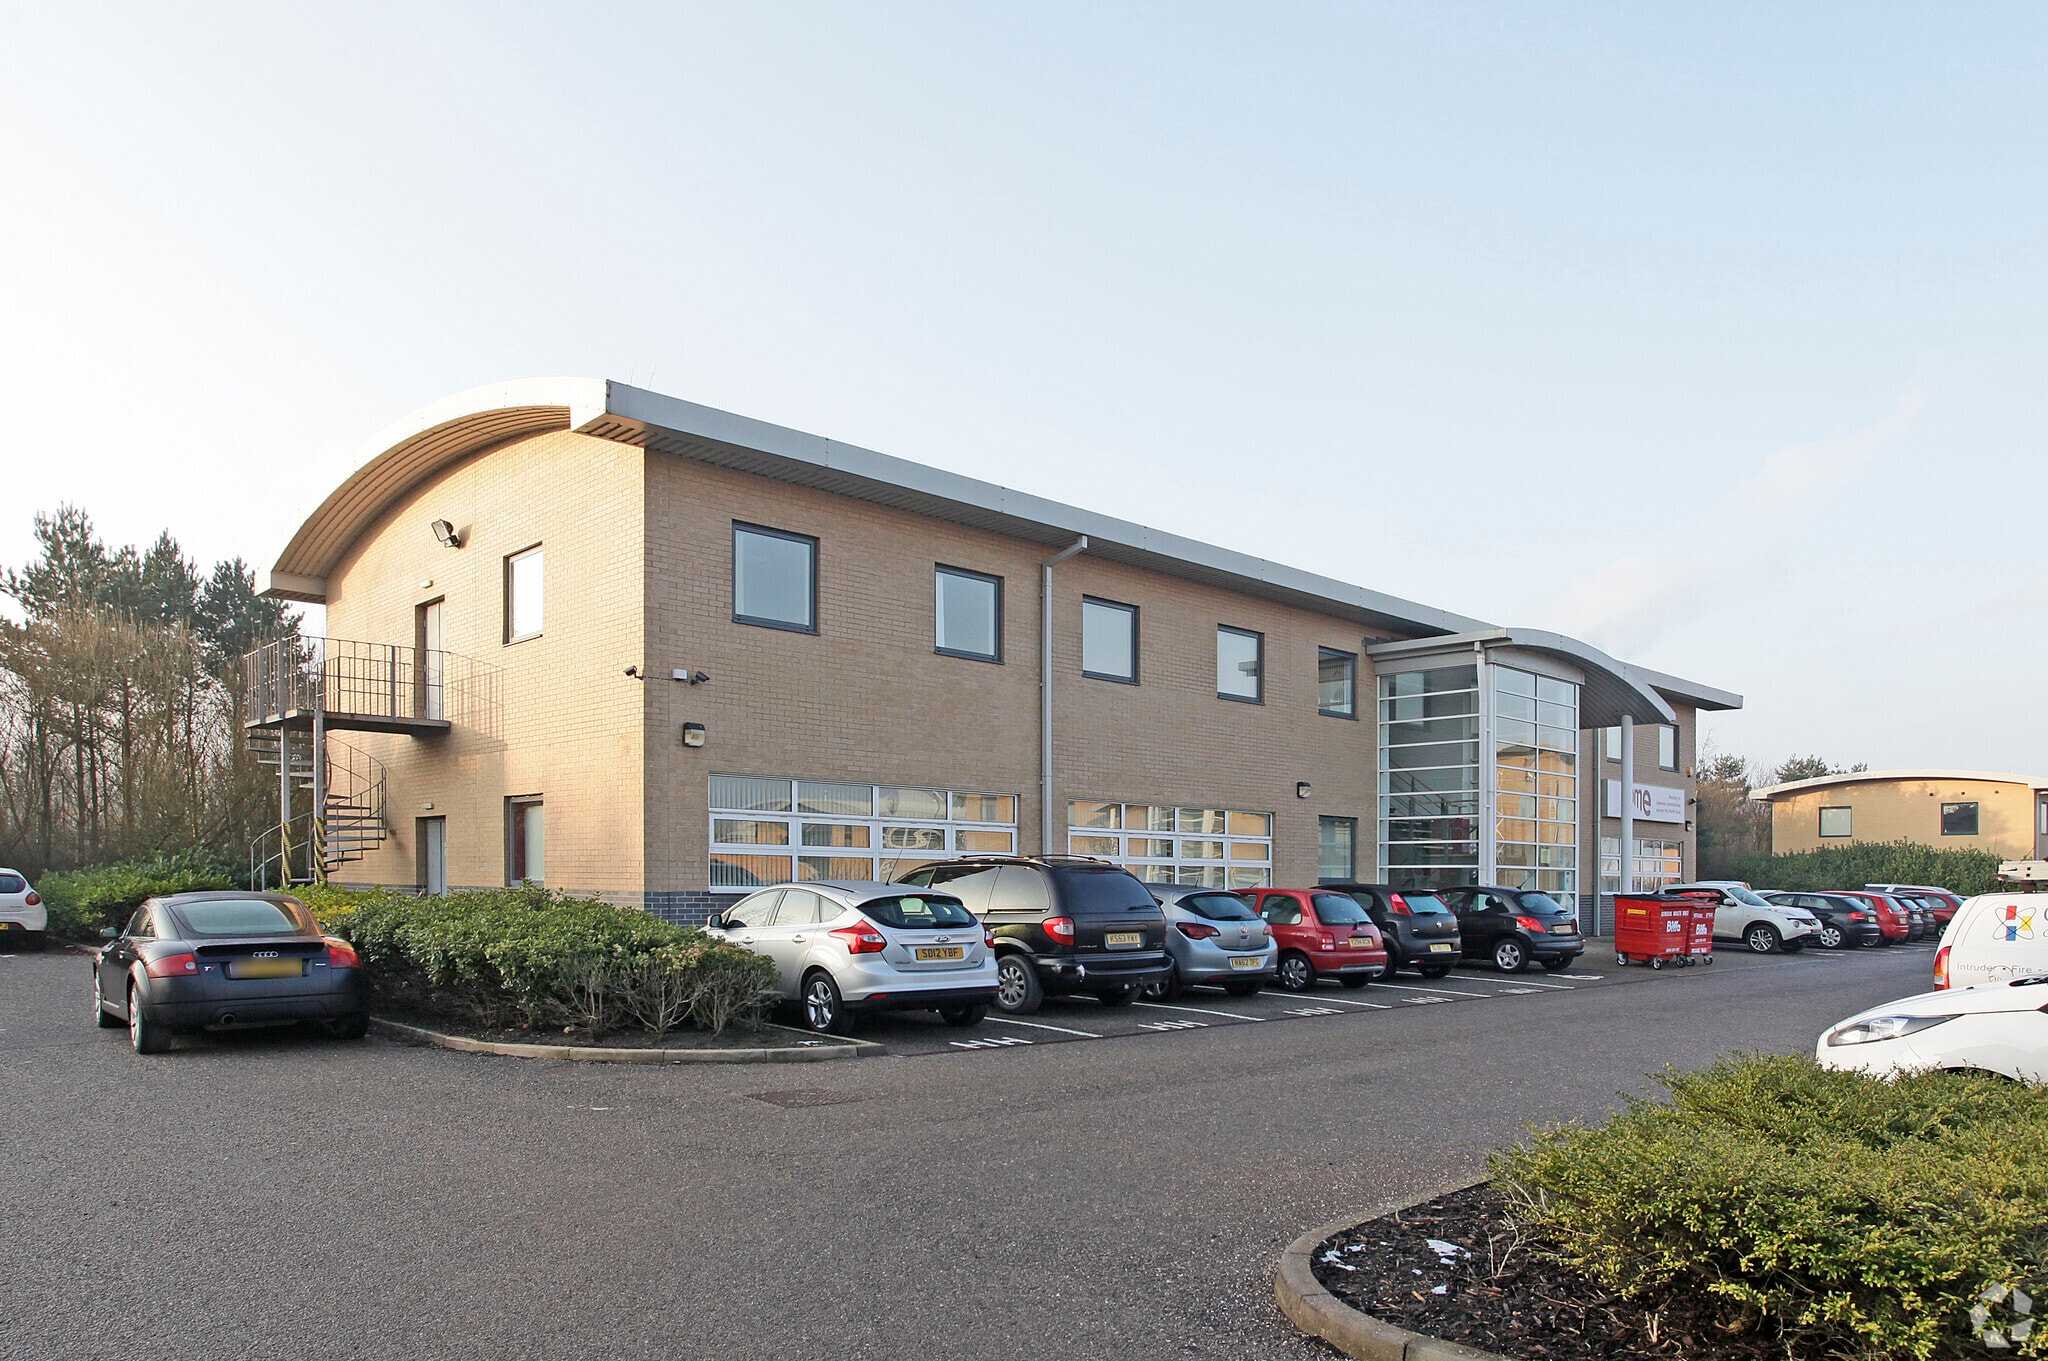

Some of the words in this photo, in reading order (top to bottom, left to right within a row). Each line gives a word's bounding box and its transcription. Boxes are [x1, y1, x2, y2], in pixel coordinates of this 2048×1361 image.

[922, 948, 941, 958] SD12
[943, 947, 958, 956] YBF
[1956, 963, 1996, 972] Intruder
[2011, 964, 2033, 974] Fire
